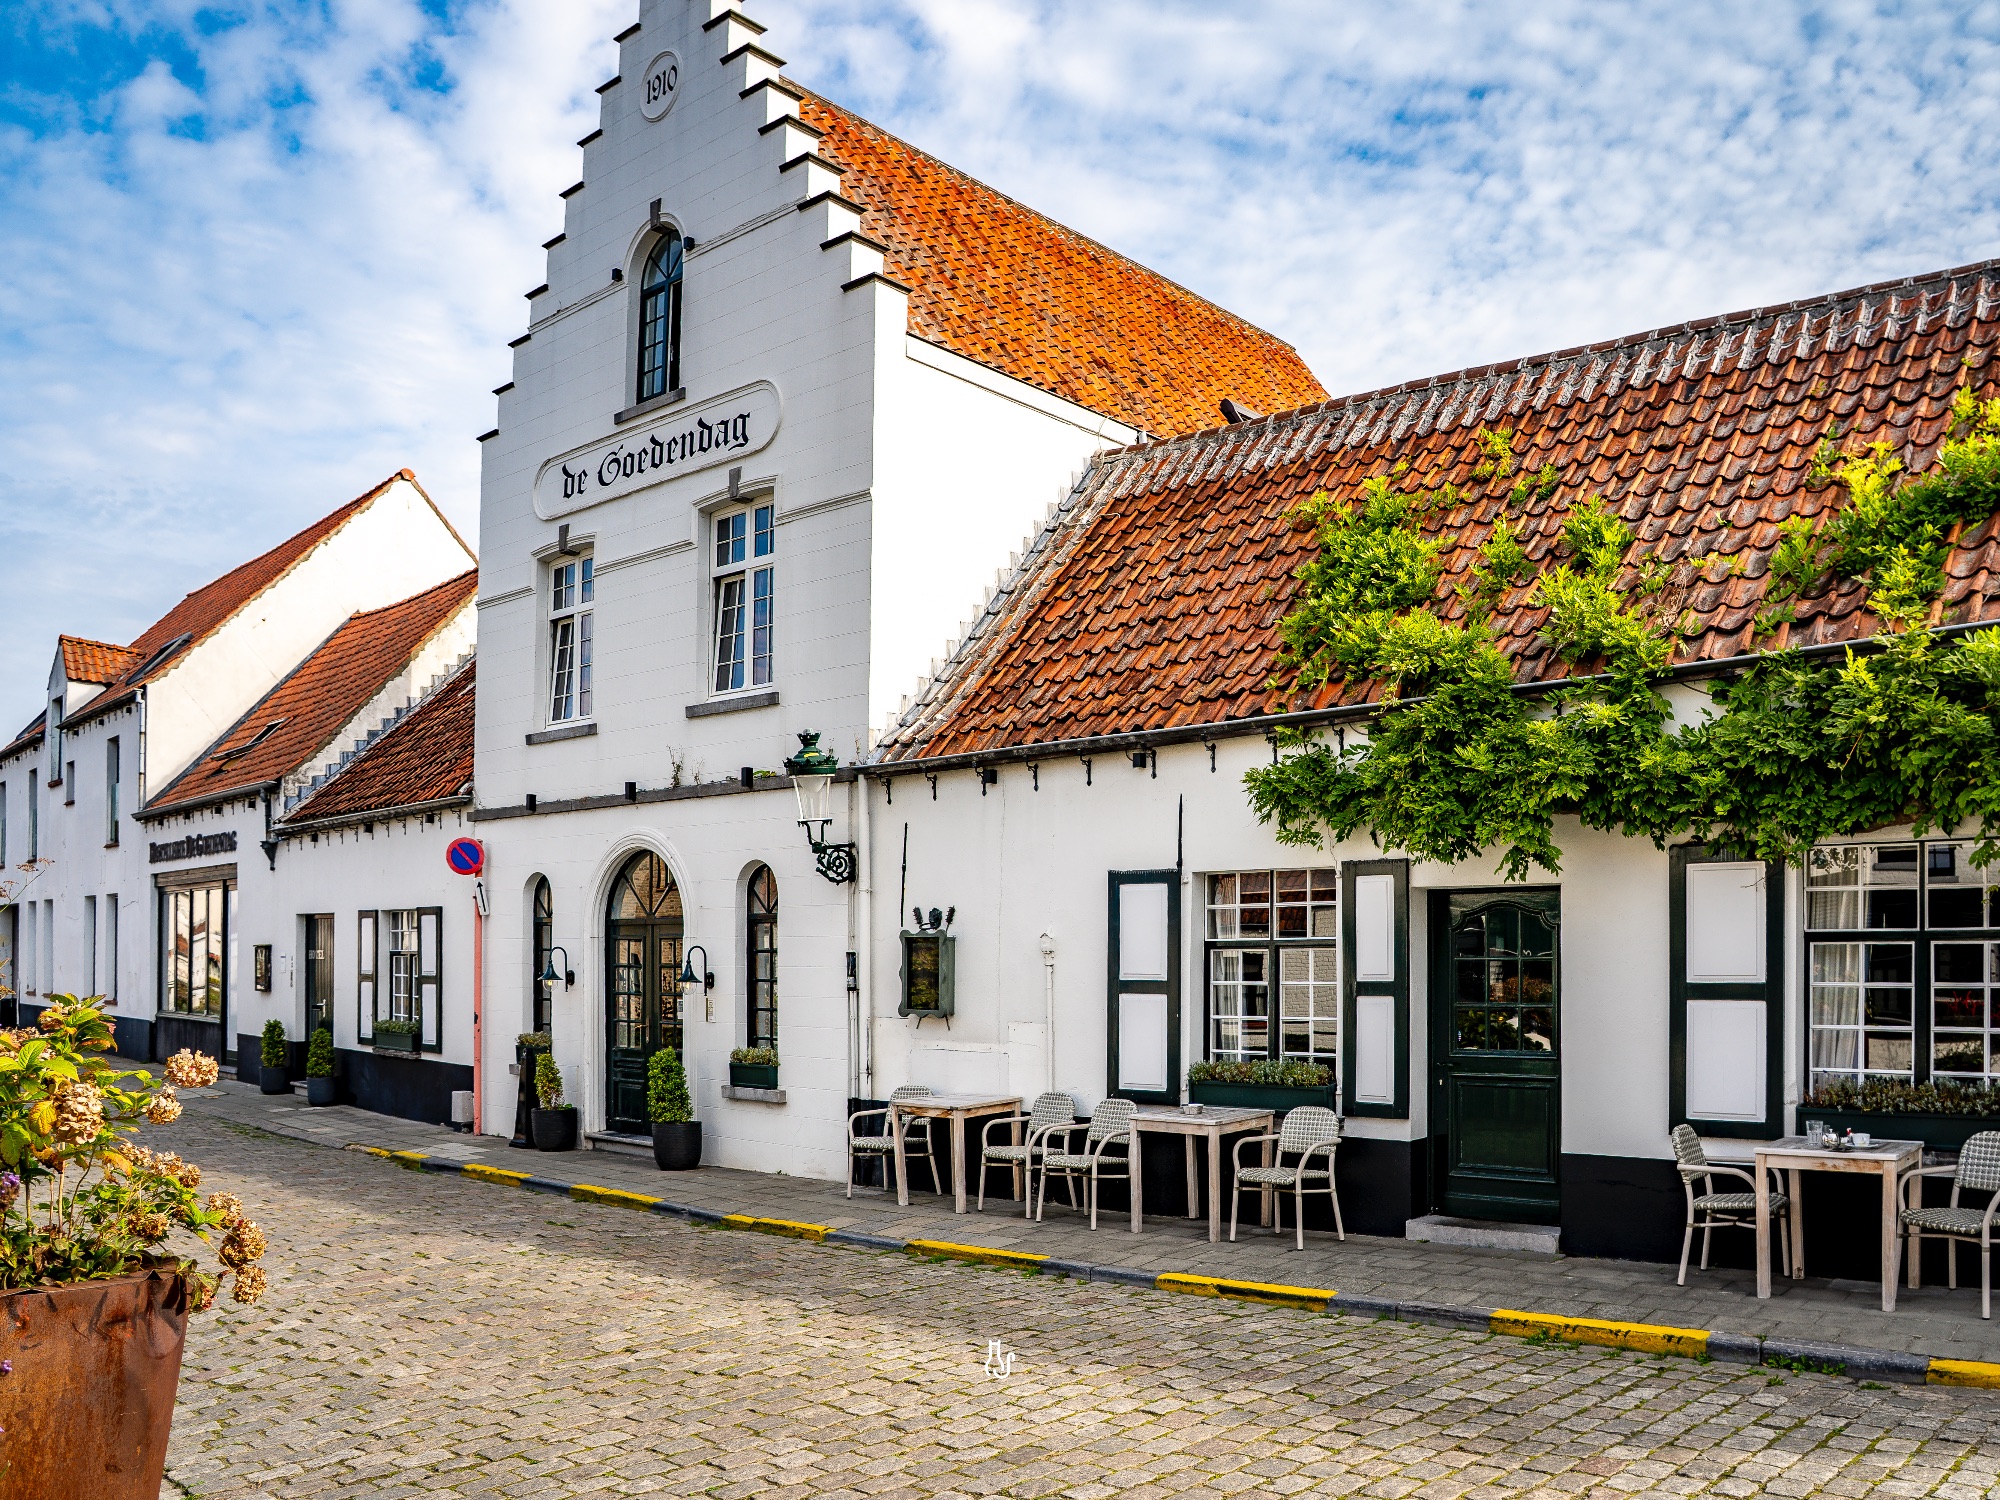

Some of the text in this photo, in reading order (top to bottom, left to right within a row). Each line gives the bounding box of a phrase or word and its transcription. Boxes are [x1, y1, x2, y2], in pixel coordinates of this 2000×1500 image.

[647, 65, 678, 105] 1910
[561, 411, 751, 500] de Goedendag
